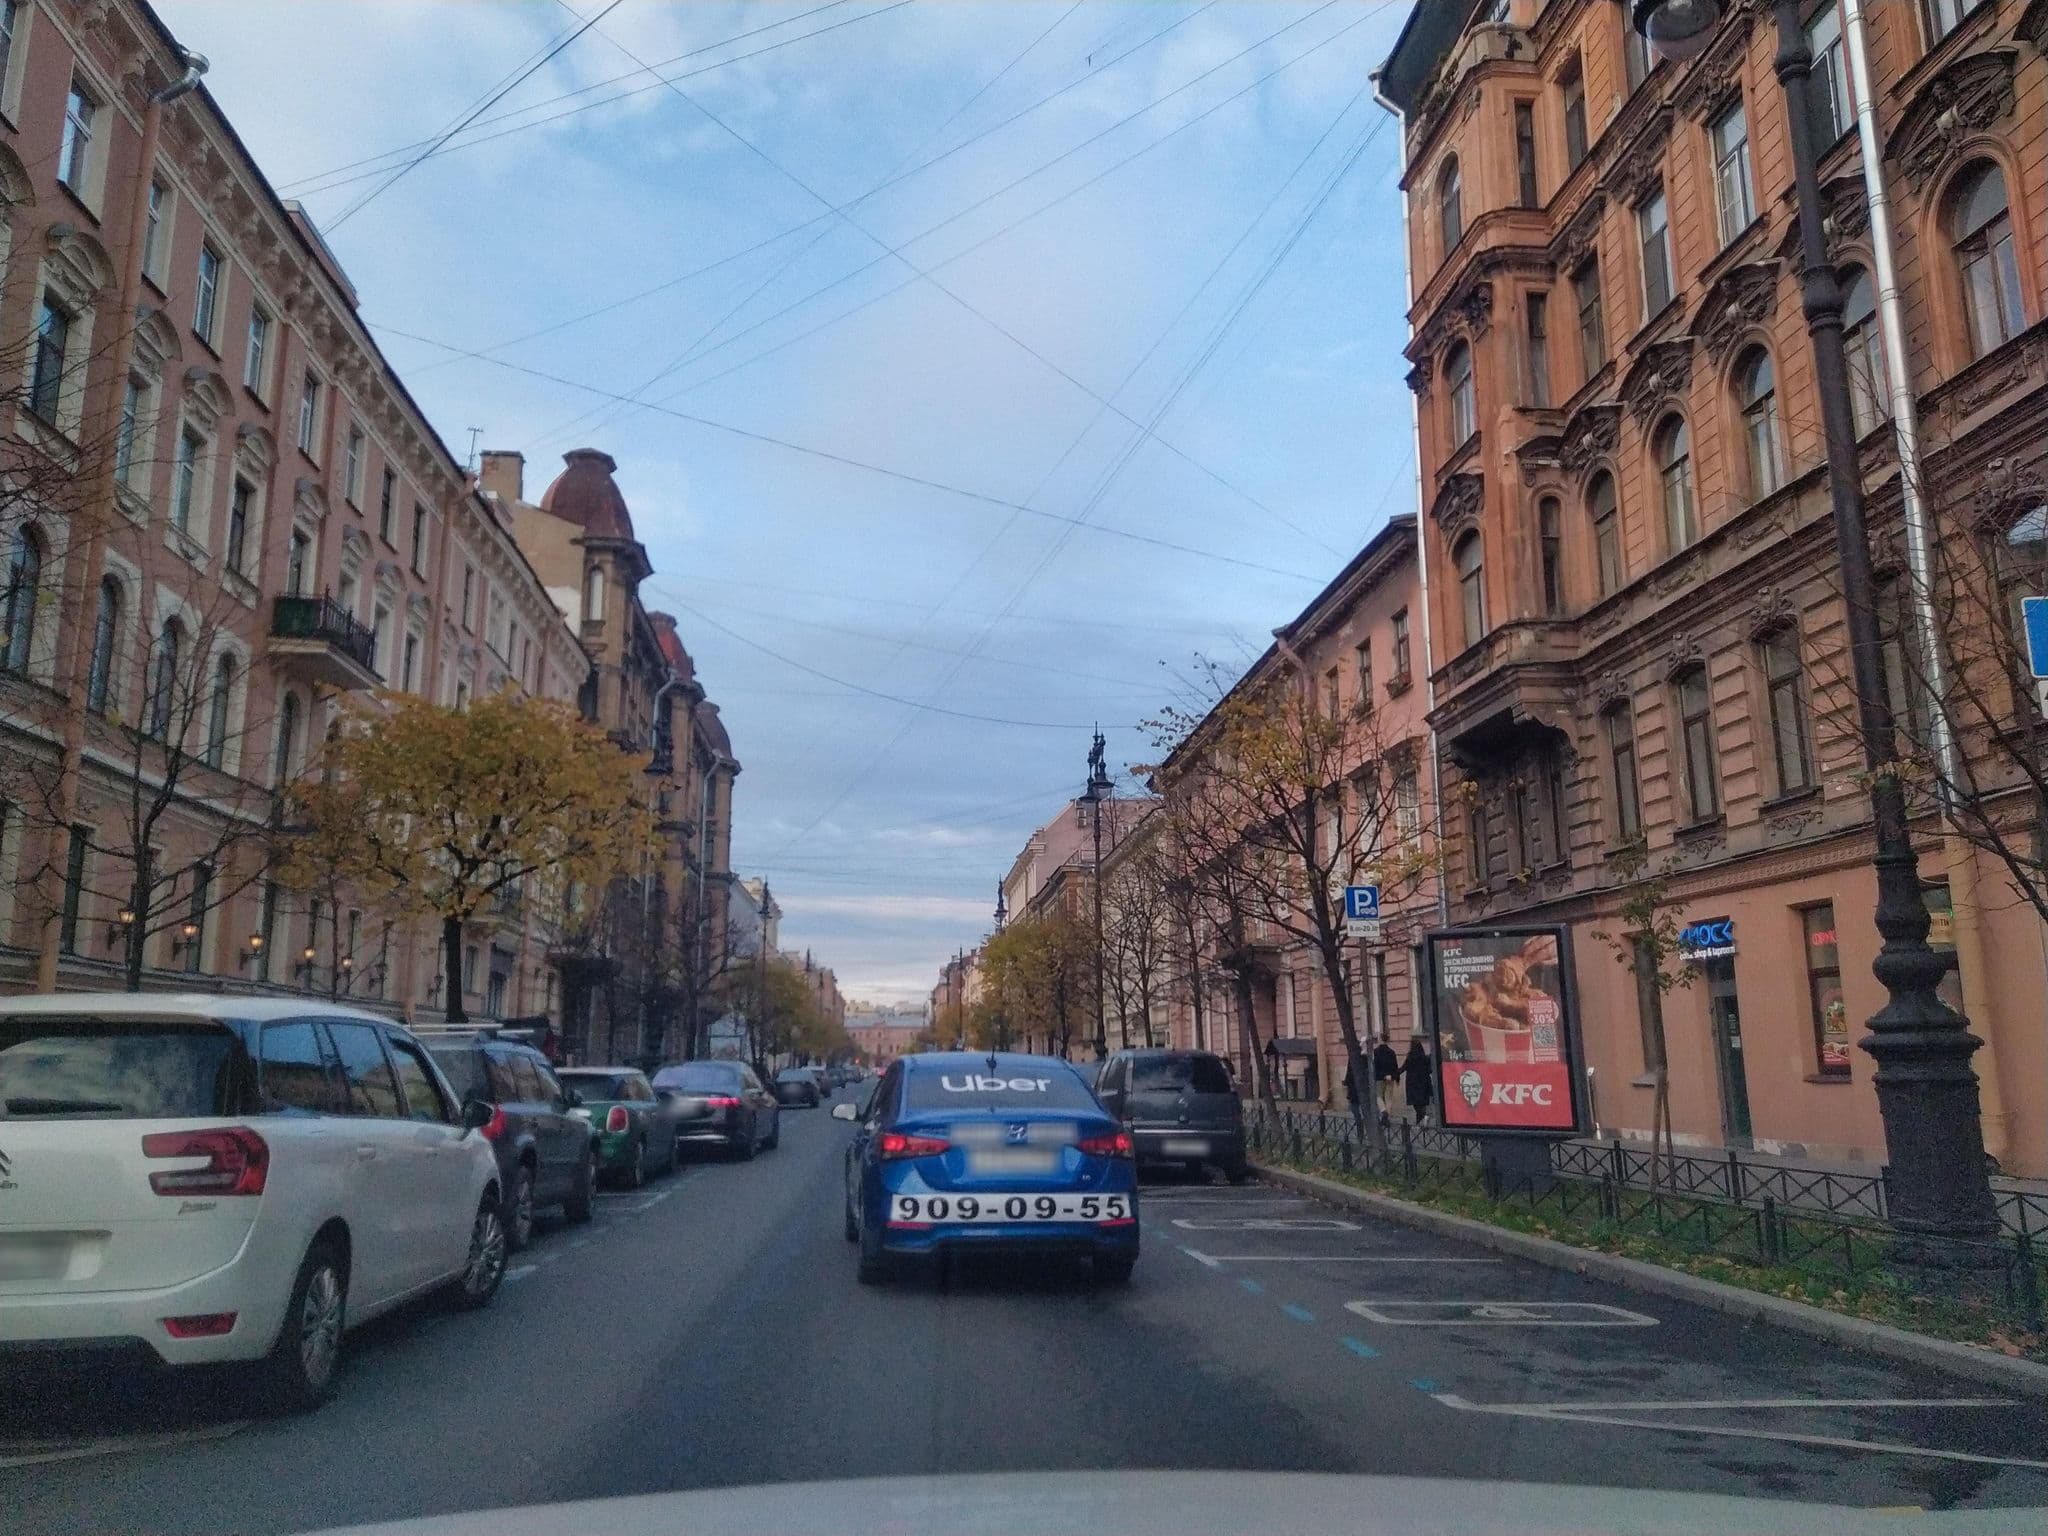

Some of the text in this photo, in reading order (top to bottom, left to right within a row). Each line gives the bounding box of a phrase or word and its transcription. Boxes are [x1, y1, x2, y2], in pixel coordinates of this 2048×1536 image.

[1443, 948, 1462, 957] KFC
[1444, 973, 1470, 988] KFC
[941, 1074, 1051, 1092] Uber
[1489, 1083, 1552, 1105] KFC
[899, 1196, 1126, 1220] 909-09-55
